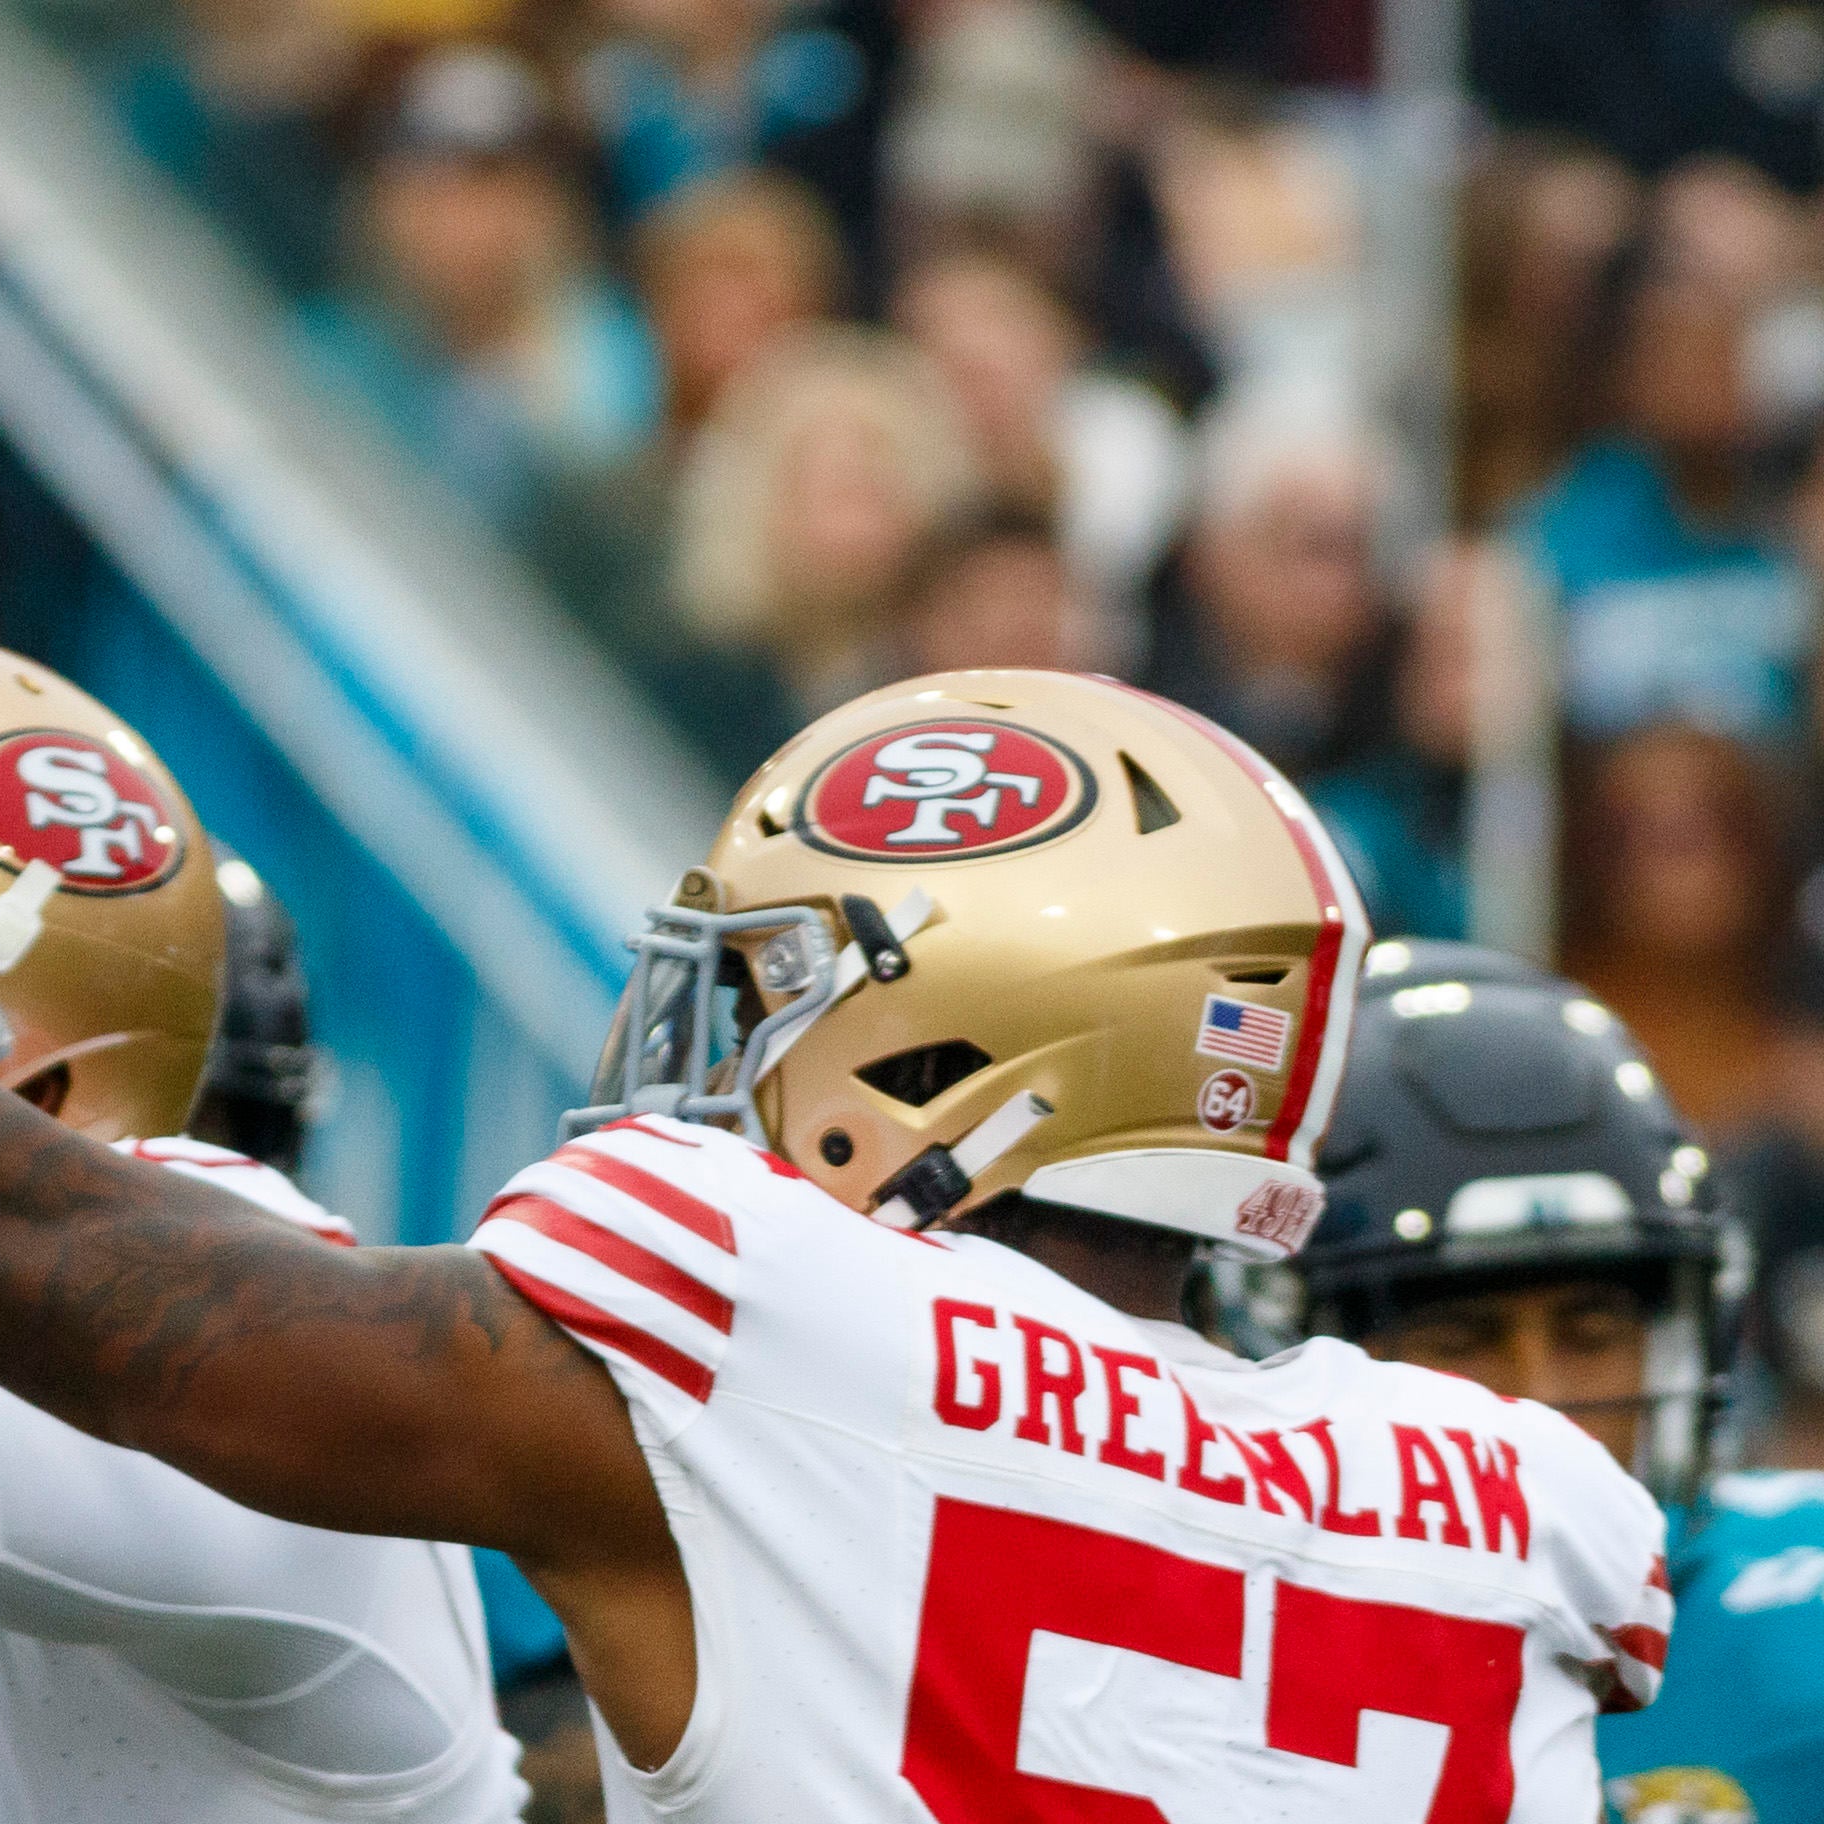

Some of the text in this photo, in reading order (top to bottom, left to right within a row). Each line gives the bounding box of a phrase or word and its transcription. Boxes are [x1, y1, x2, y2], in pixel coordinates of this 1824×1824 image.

[863, 732, 1043, 846] SF
[1205, 1081, 1249, 1122] 64
[931, 1296, 1531, 1562] GREENLAW
